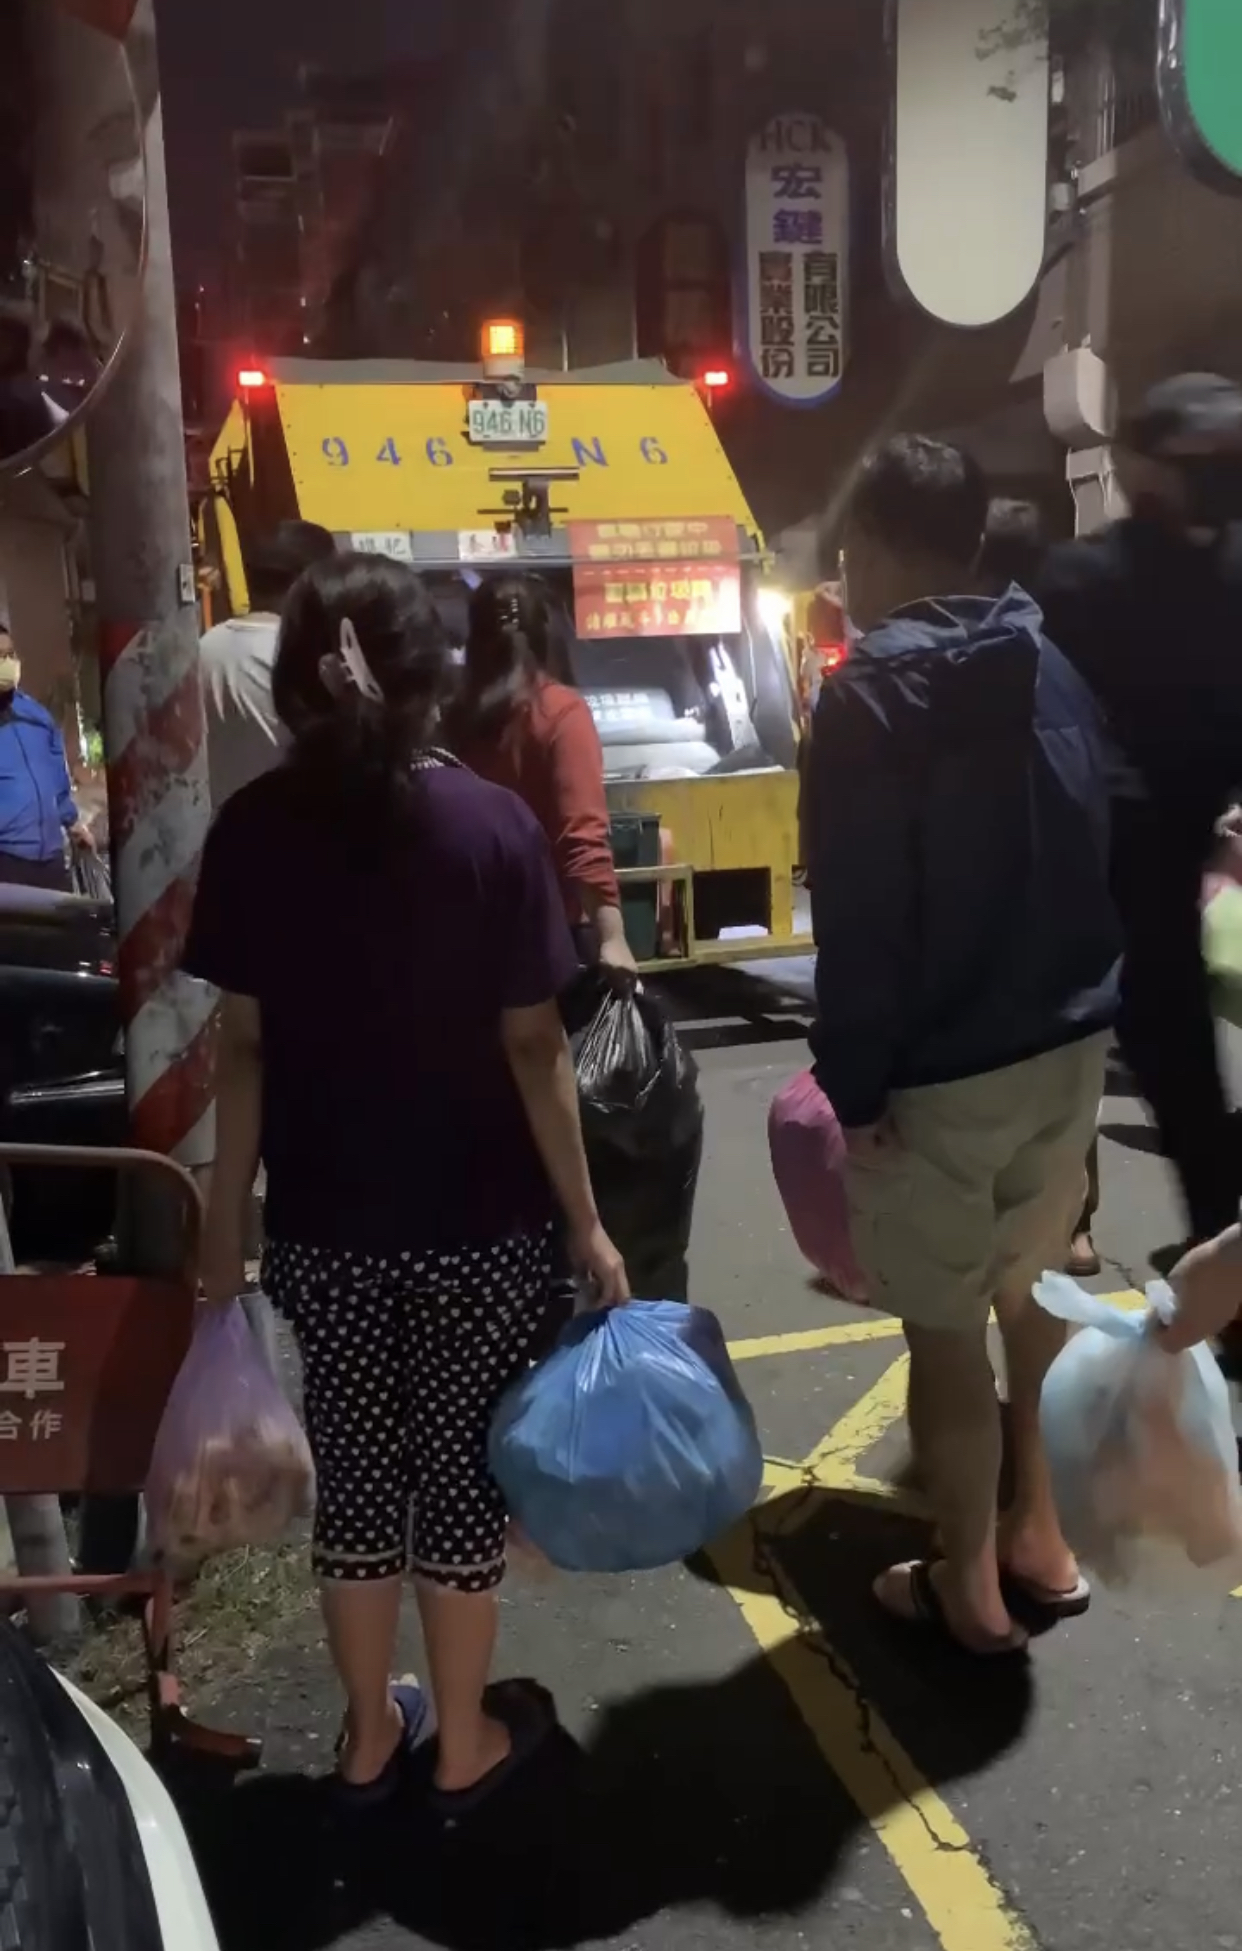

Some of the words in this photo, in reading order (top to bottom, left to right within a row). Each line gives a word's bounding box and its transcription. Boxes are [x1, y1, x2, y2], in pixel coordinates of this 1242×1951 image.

[771, 162, 823, 245] 宏鍵
[803, 249, 840, 378] 有限公司
[0, 1337, 65, 1399] 車
[0, 1410, 62, 1441] 合作
